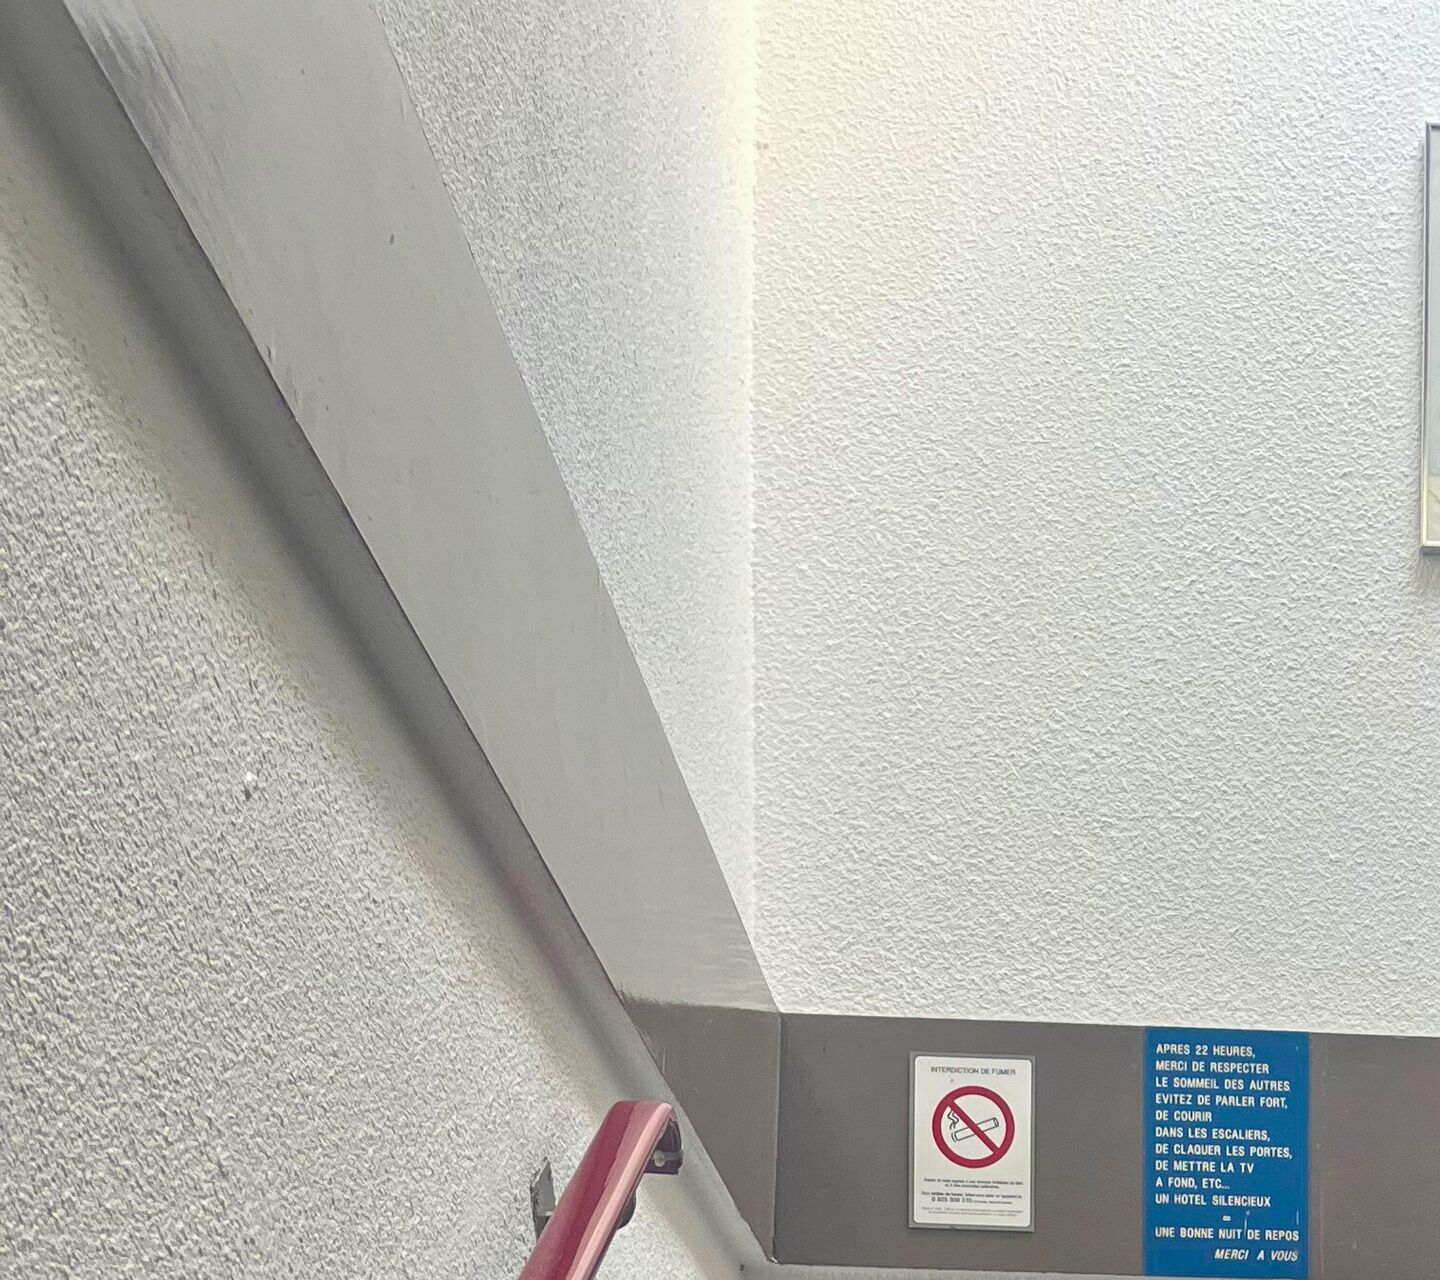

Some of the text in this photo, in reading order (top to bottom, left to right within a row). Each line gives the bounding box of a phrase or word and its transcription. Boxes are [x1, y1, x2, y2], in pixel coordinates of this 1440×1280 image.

[1156, 1044, 1256, 1058] APRES 22 HEURES,
[931, 1066, 979, 1074] INTERDICTION
[1156, 1061, 1269, 1074] MERCI DE RESPECTER
[1156, 1077, 1168, 1087] LE
[1173, 1078, 1219, 1089] SOMMEIL
[1225, 1079, 1244, 1090] DES
[1156, 1093, 1288, 1109] EVITEZ DE PARLER FORT,
[1156, 1110, 1212, 1122] DE COURIR
[1156, 1127, 1270, 1142] DANS LES ESCALIERS,
[1156, 1144, 1292, 1159] DE CLAQUER LES PORTES,
[1156, 1160, 1254, 1173] DE METTRE LA TV
[1156, 1177, 1163, 1187] A
[1168, 1177, 1197, 1189] FOND,
[1155, 1194, 1271, 1207] UN HOTEL SILENCIEUX
[1155, 1227, 1299, 1241] UNE BONNE NUIT DE REPOS
[1214, 1248, 1299, 1261] MERCI A VOUS
